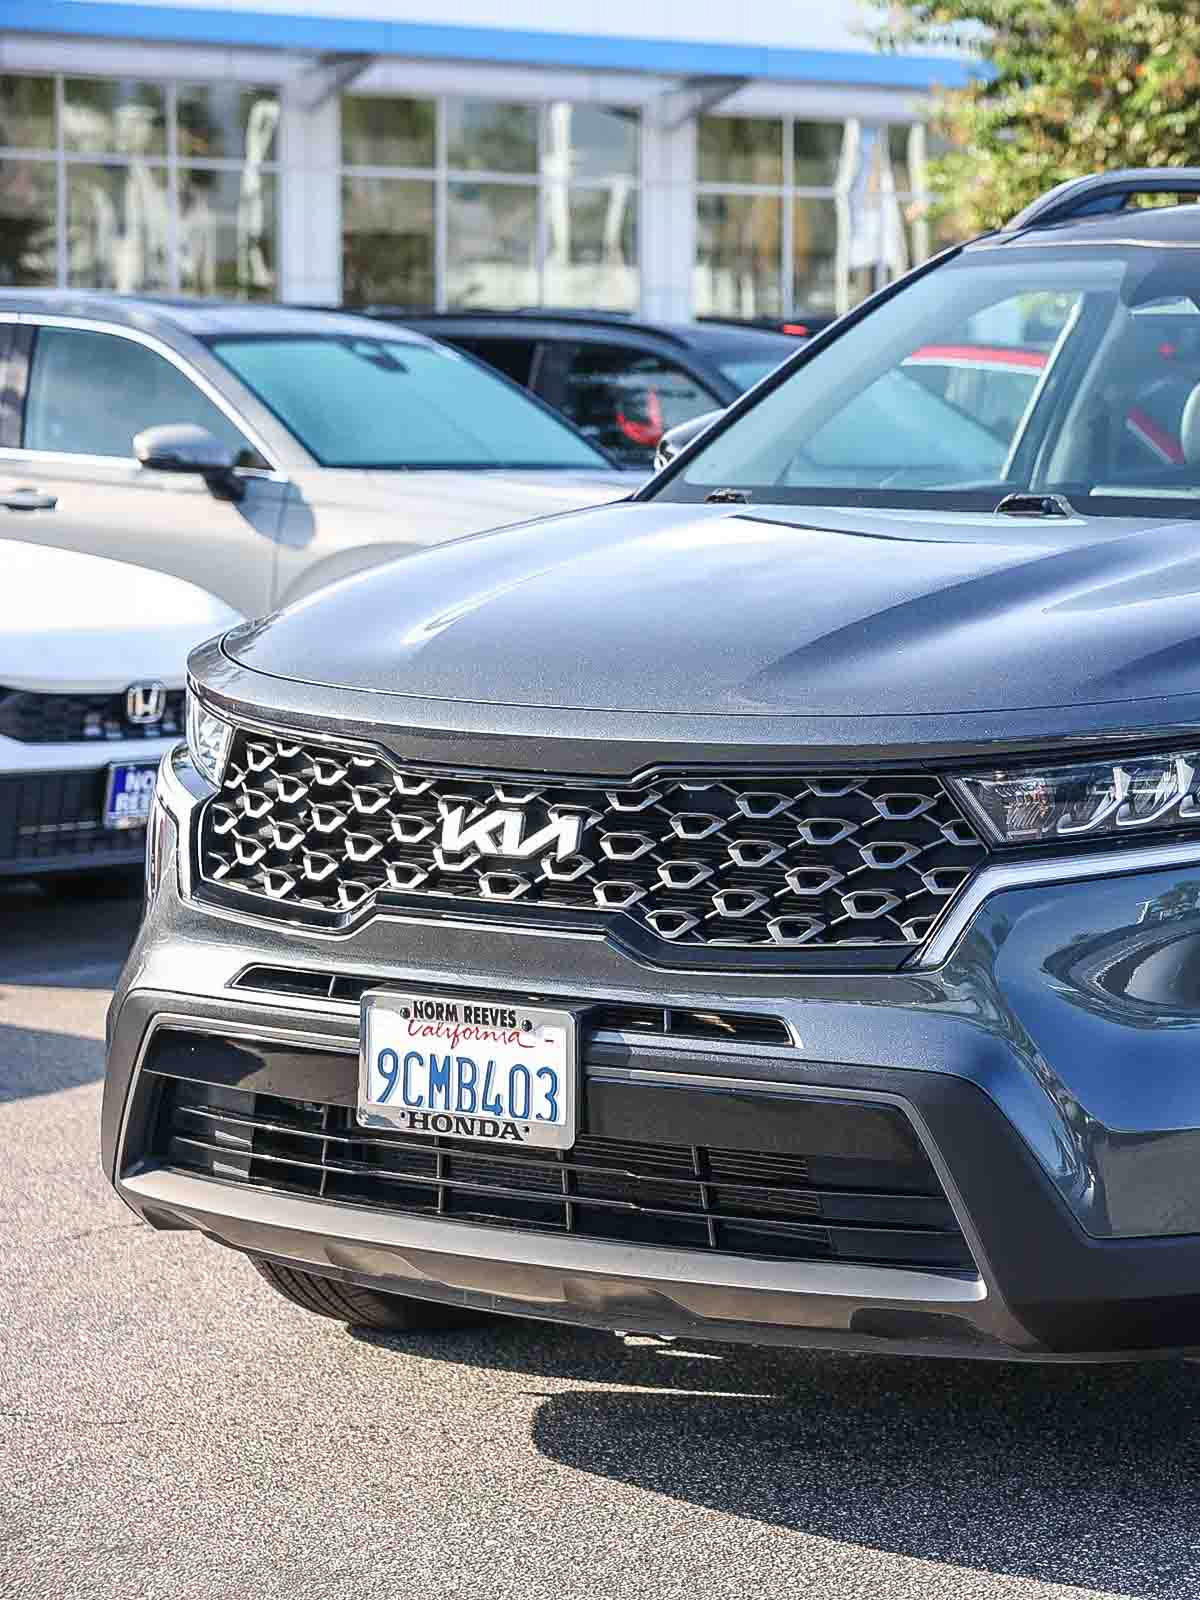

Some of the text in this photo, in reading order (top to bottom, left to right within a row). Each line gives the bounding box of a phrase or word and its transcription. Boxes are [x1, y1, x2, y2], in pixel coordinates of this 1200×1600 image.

[413, 1000, 517, 1029] NORM REEVES
[407, 1019, 536, 1049] California
[376, 1047, 559, 1123] 9CMB403
[406, 1111, 524, 1142] HONDA
